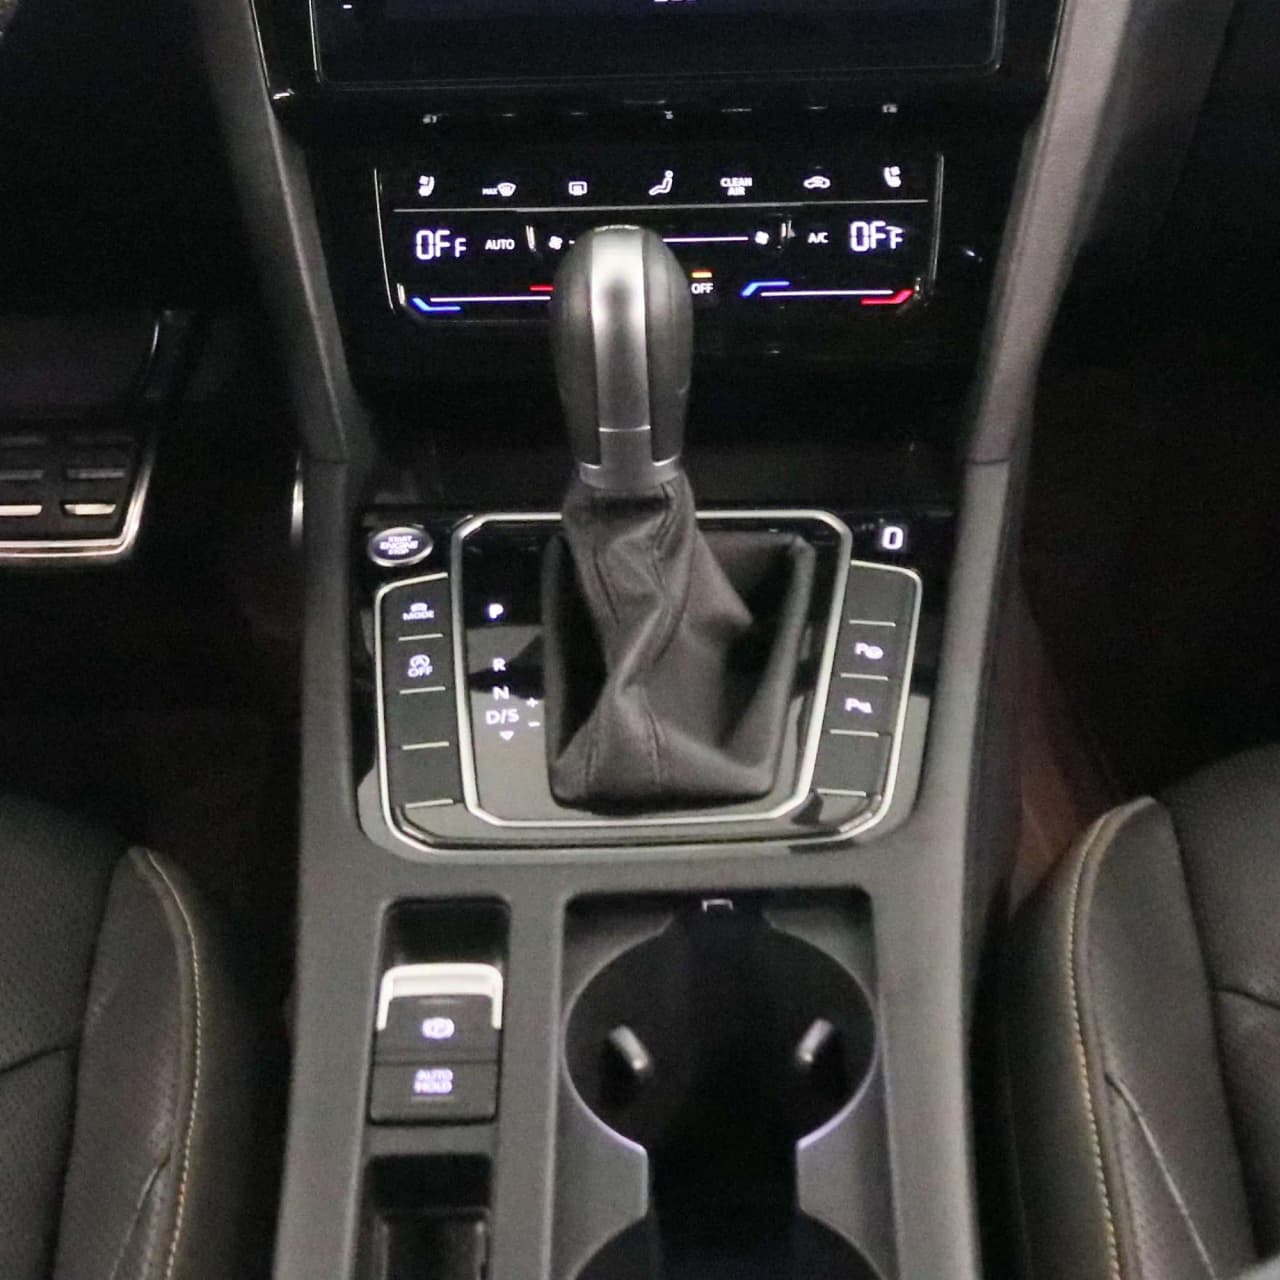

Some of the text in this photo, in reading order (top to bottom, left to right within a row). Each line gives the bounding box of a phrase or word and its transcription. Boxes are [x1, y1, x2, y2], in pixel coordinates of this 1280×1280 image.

[720, 177, 753, 188] CLEAN
[727, 186, 746, 196] AIR
[807, 232, 829, 244] A/C
[485, 239, 515, 250] AUTO
[691, 282, 714, 295] OFF
[402, 610, 435, 621] MODE
[488, 603, 504, 619] P
[492, 657, 506, 672] R
[408, 667, 433, 678] OFF
[493, 686, 510, 700] N
[486, 708, 520, 724] D/S
